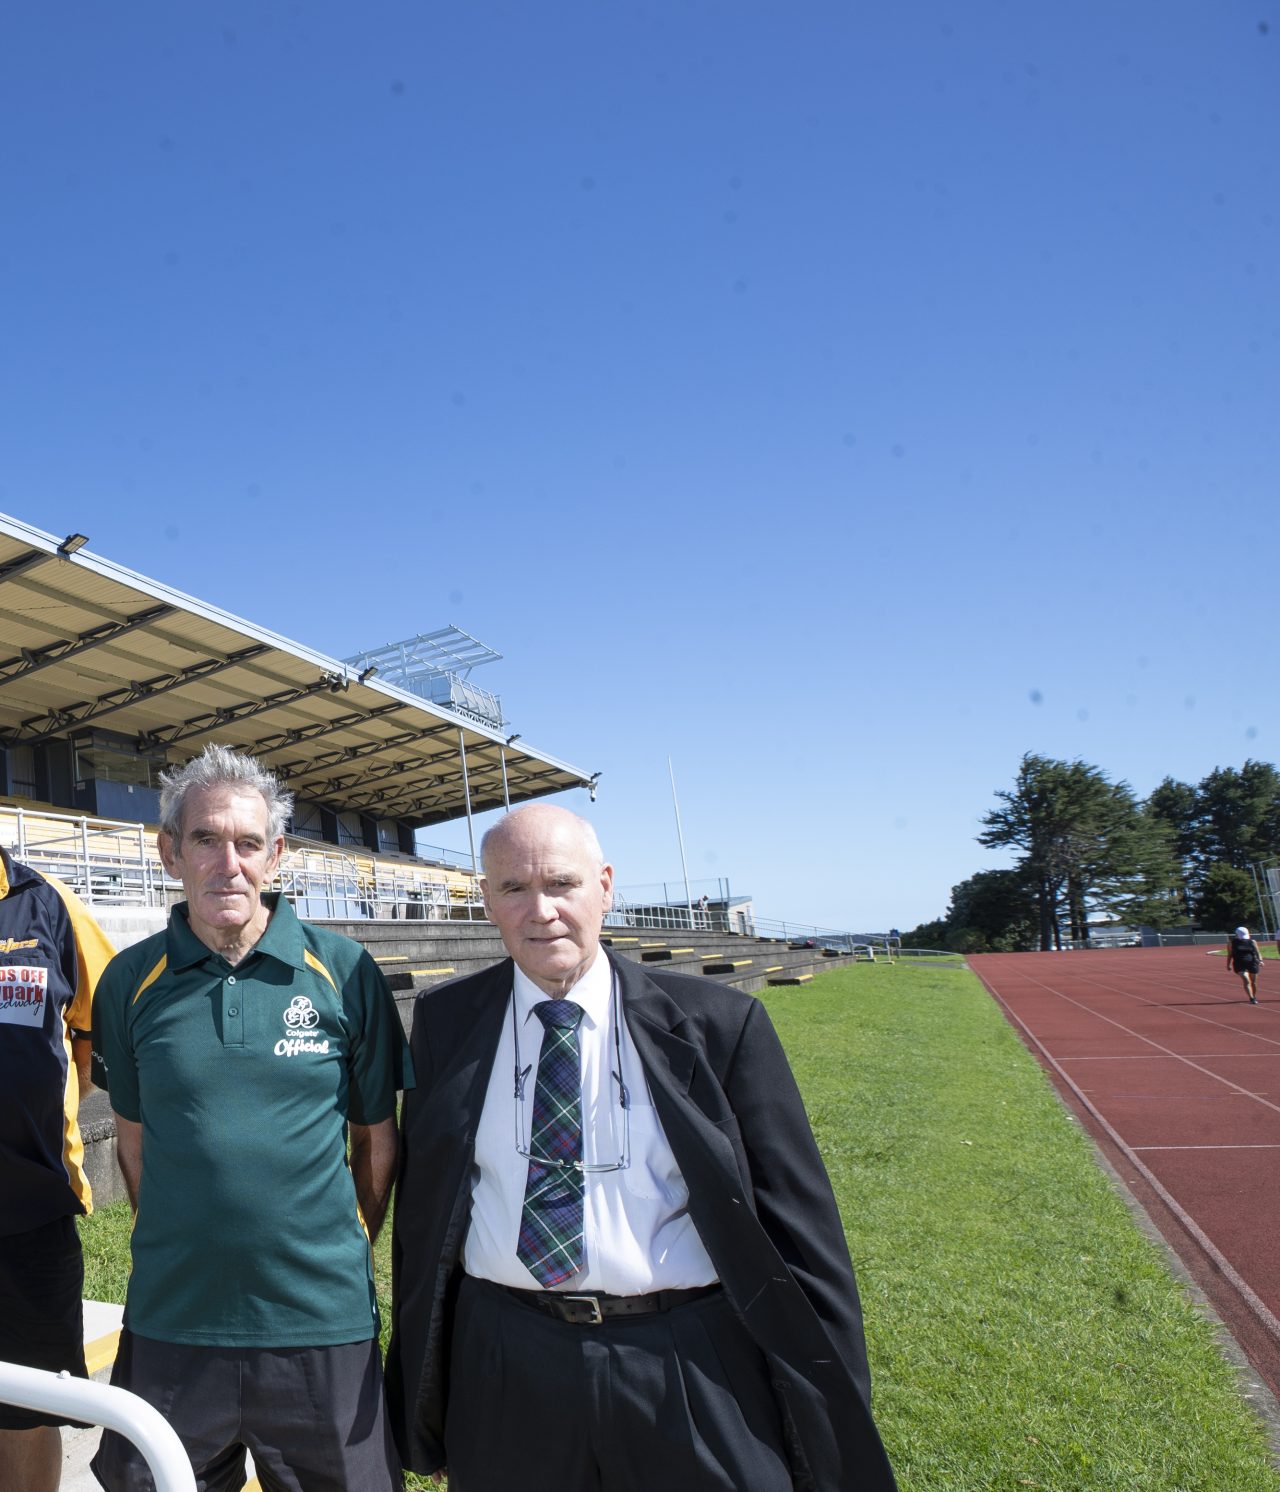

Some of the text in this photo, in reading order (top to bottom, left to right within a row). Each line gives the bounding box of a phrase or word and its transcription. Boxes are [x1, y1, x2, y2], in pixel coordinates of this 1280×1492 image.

[21, 969, 45, 983] OFF
[285, 1030, 320, 1038] Colgate
[274, 1039, 330, 1058] Official
